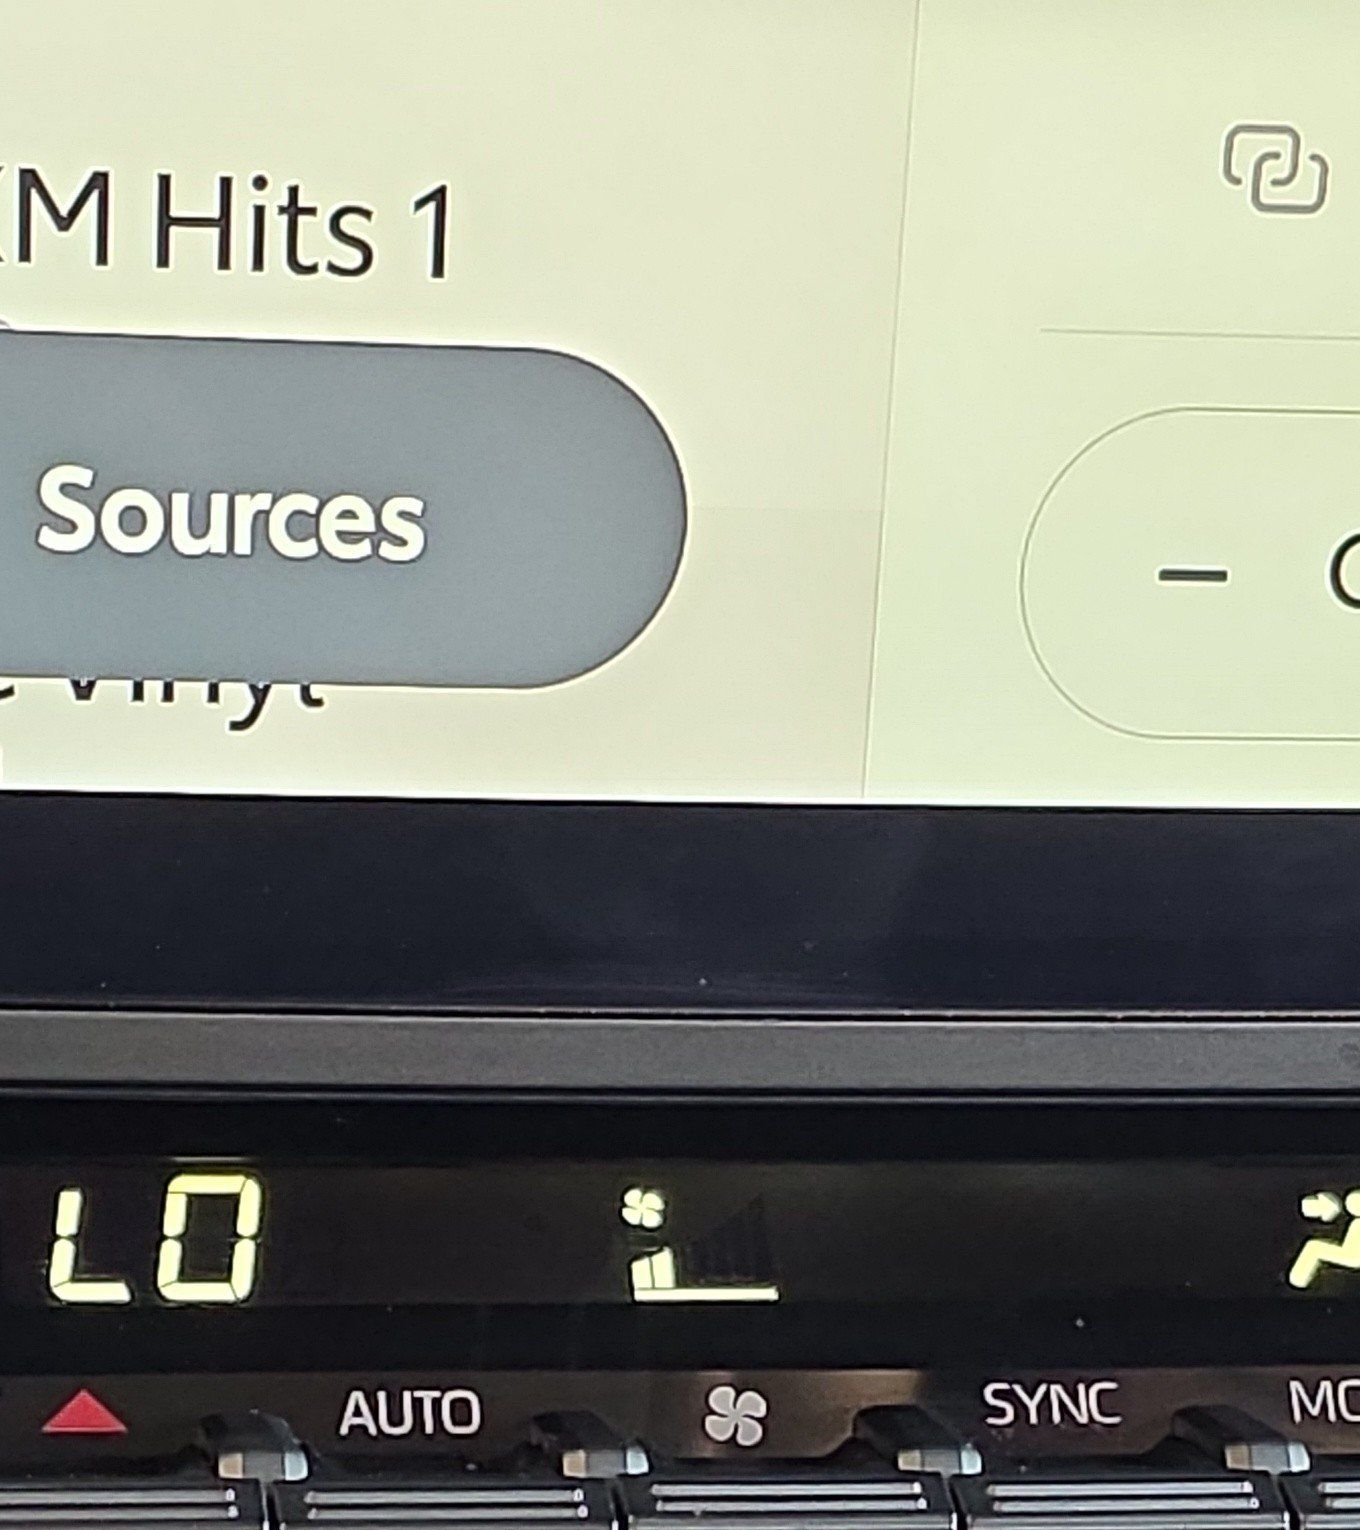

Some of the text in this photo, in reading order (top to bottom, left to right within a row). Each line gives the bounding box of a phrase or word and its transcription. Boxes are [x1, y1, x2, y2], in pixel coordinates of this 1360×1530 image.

[157, 174, 374, 276] Hits
[414, 184, 448, 278] 1
[38, 465, 426, 562] Sources
[338, 1388, 482, 1436] AUTO
[982, 1380, 1122, 1426] SYNC
